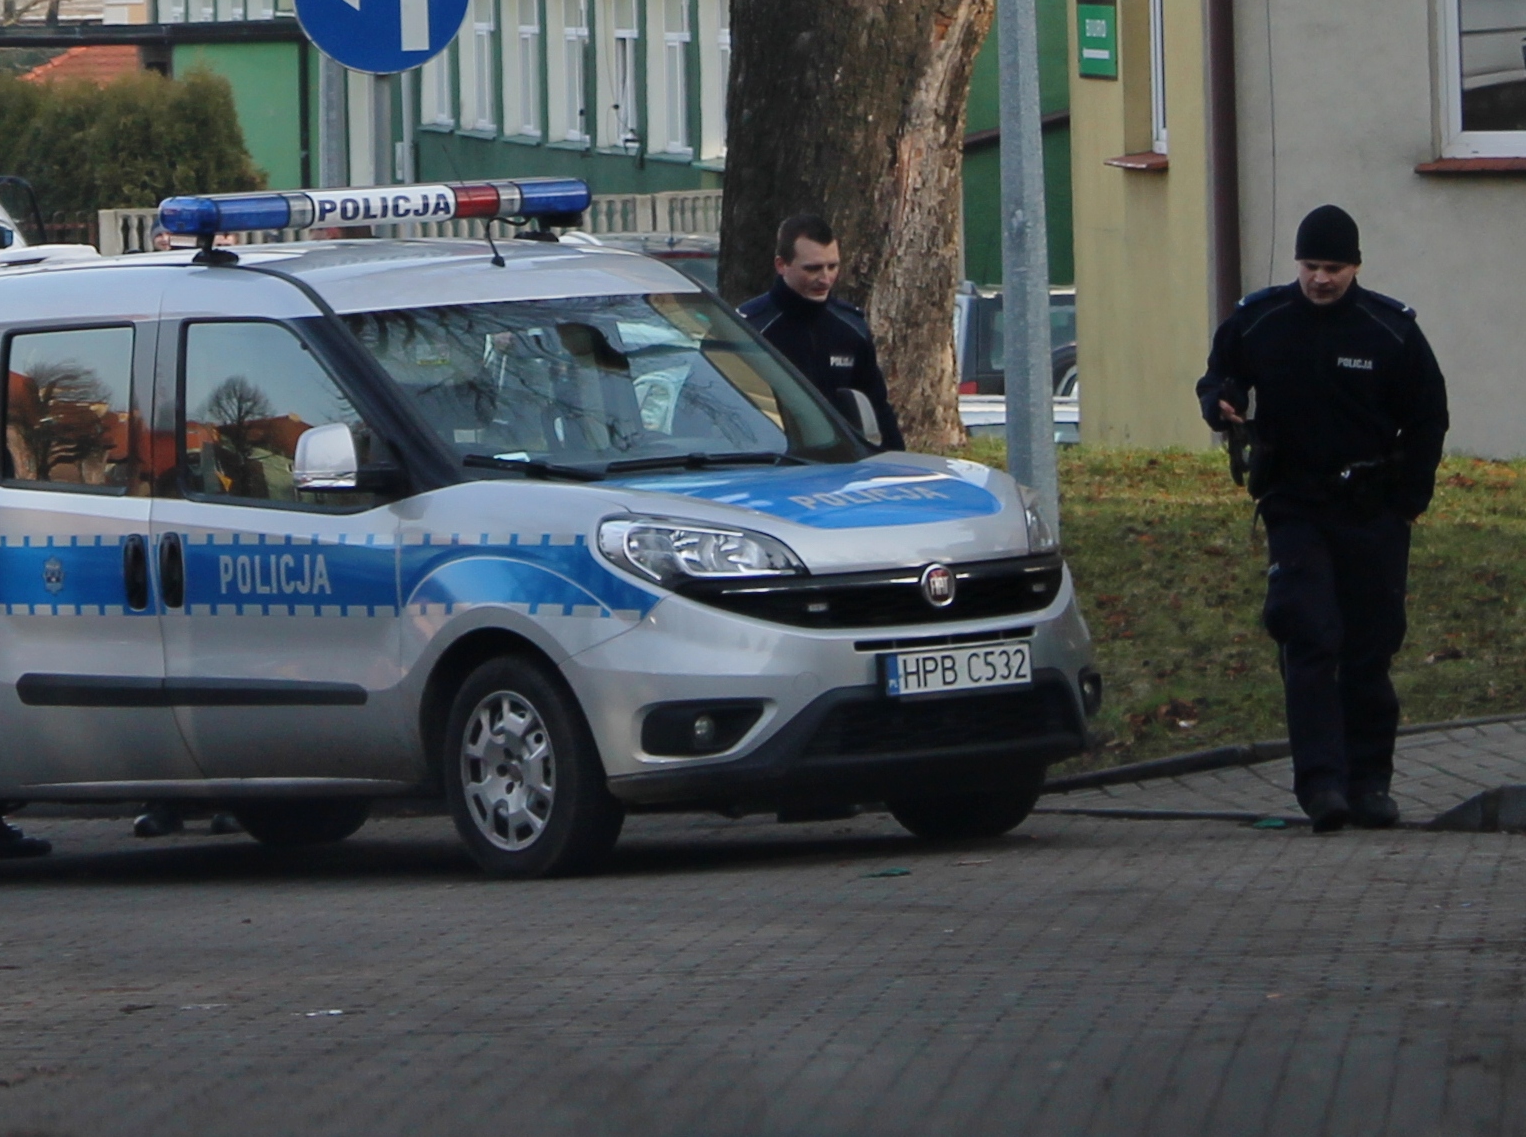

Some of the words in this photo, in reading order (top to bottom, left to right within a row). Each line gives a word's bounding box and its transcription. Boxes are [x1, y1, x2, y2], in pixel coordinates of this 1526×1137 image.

[318, 193, 451, 222] POLICJA
[1337, 357, 1373, 370] POLICJA
[788, 486, 951, 510] POLICJA
[219, 553, 332, 595] POLICJA
[930, 576, 949, 596] FIAT
[903, 654, 958, 689] HPB
[967, 648, 1027, 683] C532
